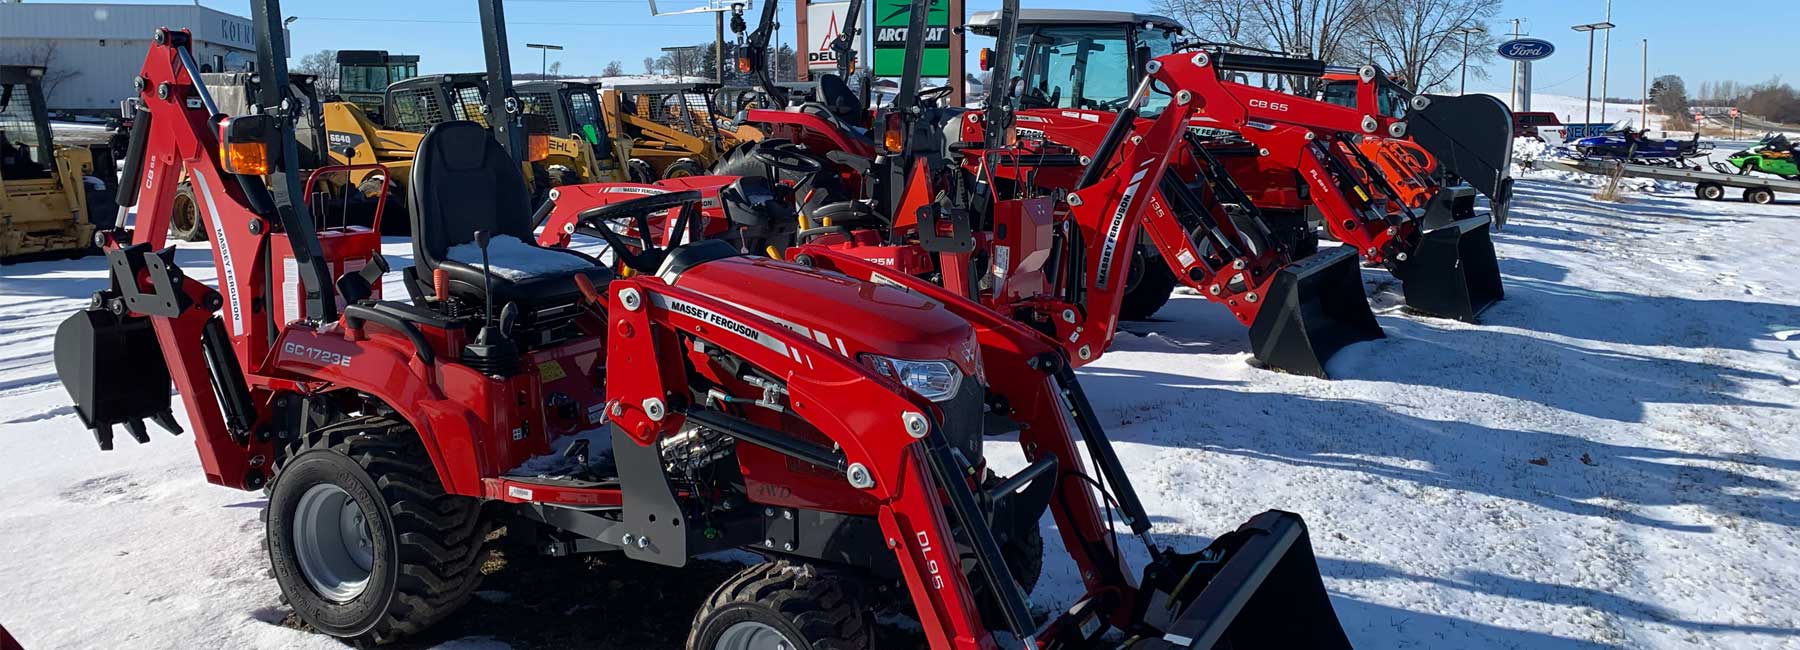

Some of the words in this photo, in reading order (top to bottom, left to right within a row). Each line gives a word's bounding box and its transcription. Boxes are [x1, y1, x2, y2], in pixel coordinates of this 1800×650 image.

[877, 28, 909, 41] ARCT
[1509, 43, 1543, 56] Ford
[1249, 99, 1268, 109] CB
[1270, 102, 1289, 112] 65
[146, 170, 154, 190] CB
[1099, 244, 1113, 284] MASSEY
[1108, 194, 1132, 243] FERGUSON
[217, 228, 231, 267] MASSEY
[227, 270, 240, 321] FERGUSON
[671, 301, 709, 320] MASSEY
[710, 314, 759, 340] FERGUSON
[917, 531, 945, 589] DL95
